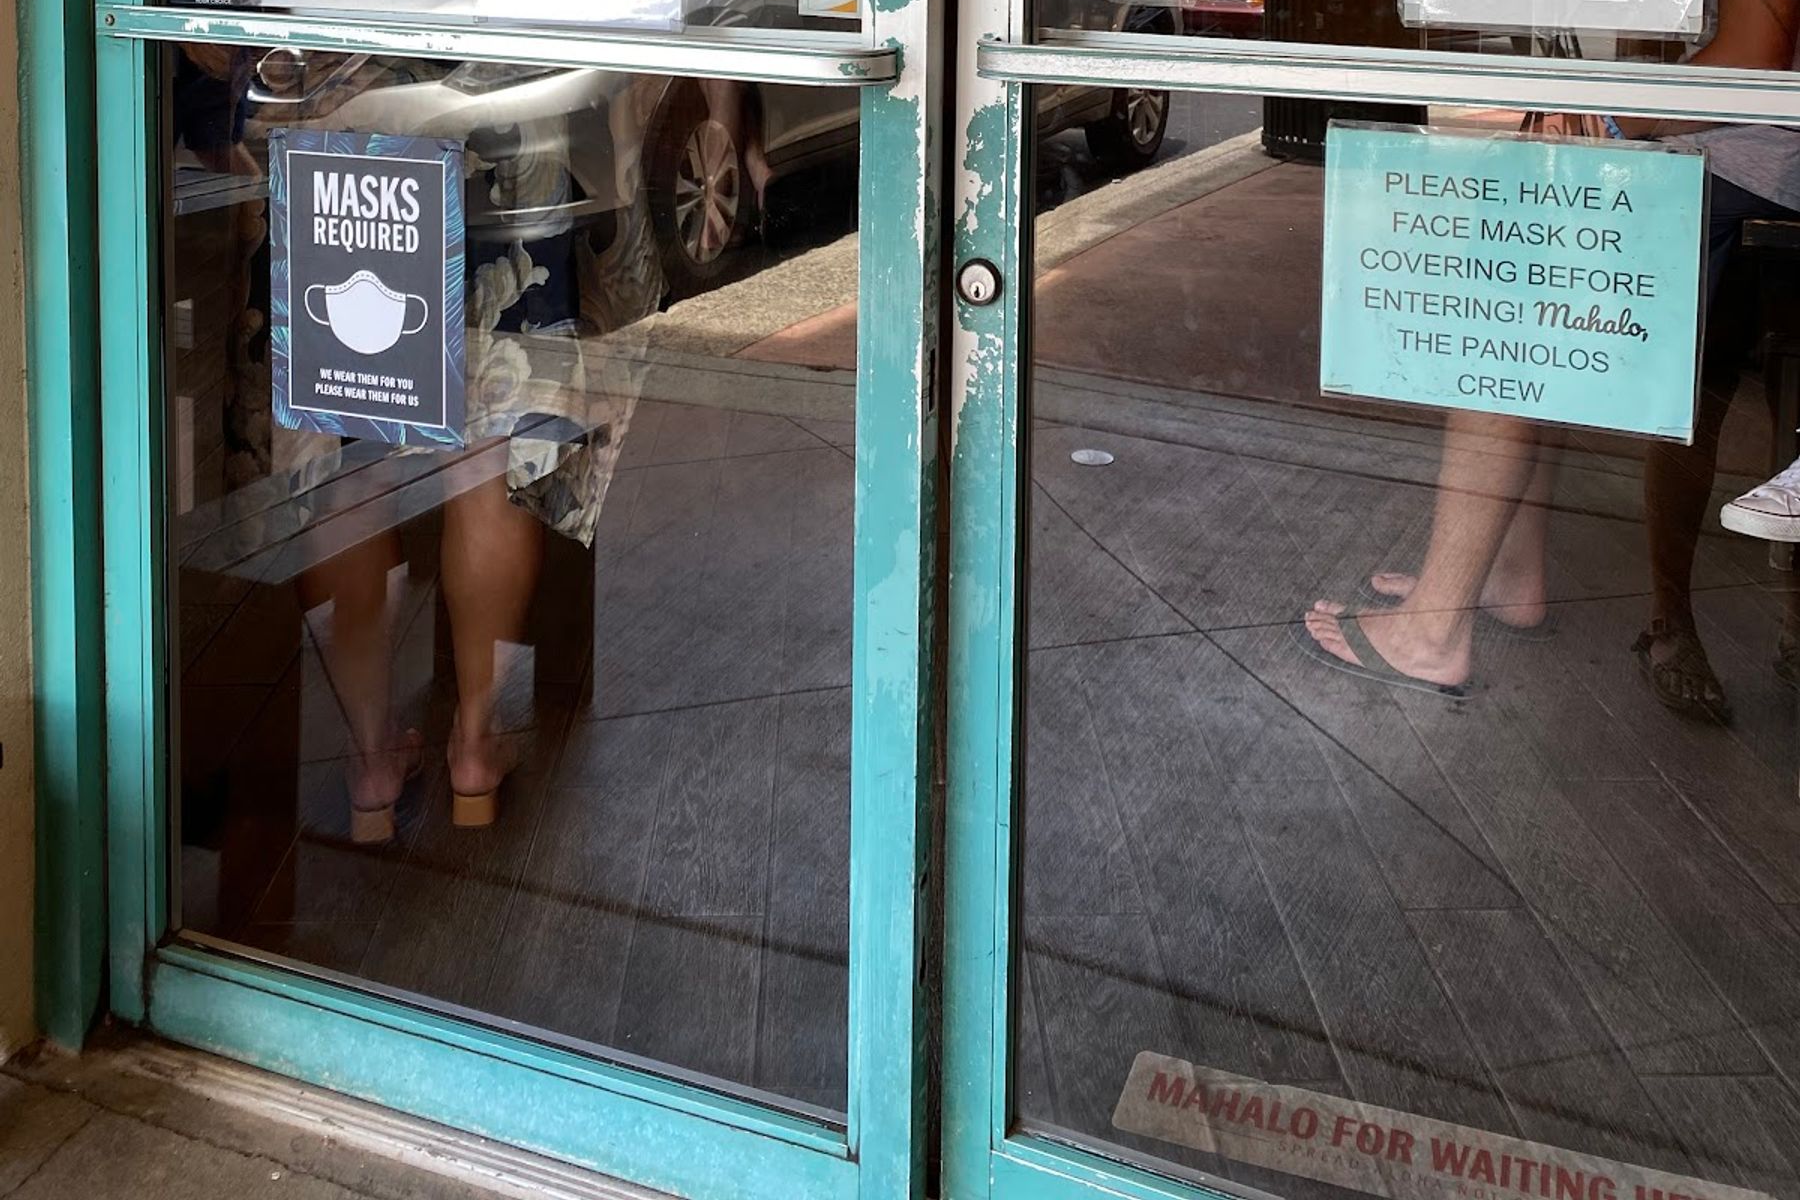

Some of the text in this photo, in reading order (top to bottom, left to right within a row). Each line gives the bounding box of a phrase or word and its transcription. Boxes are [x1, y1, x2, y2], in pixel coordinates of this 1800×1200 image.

[313, 171, 420, 224] MASKS
[1385, 171, 1633, 213] PLEASE, HAVE A
[313, 216, 420, 254] REQUIRED
[1392, 211, 1622, 253] FACE MASK OR
[1360, 247, 1656, 298] COVERING BEFORE
[1364, 286, 1649, 342] ENTERING! Mahalo,
[1397, 328, 1610, 374] THE PANIOLOS
[315, 382, 420, 408] PLEASE WEAR THEM FOR US
[320, 367, 414, 390] WE WEAR THEM FOR YOU
[1456, 373, 1545, 403] CREW
[1146, 1071, 1617, 1200] MAHALO FOR WAITING
